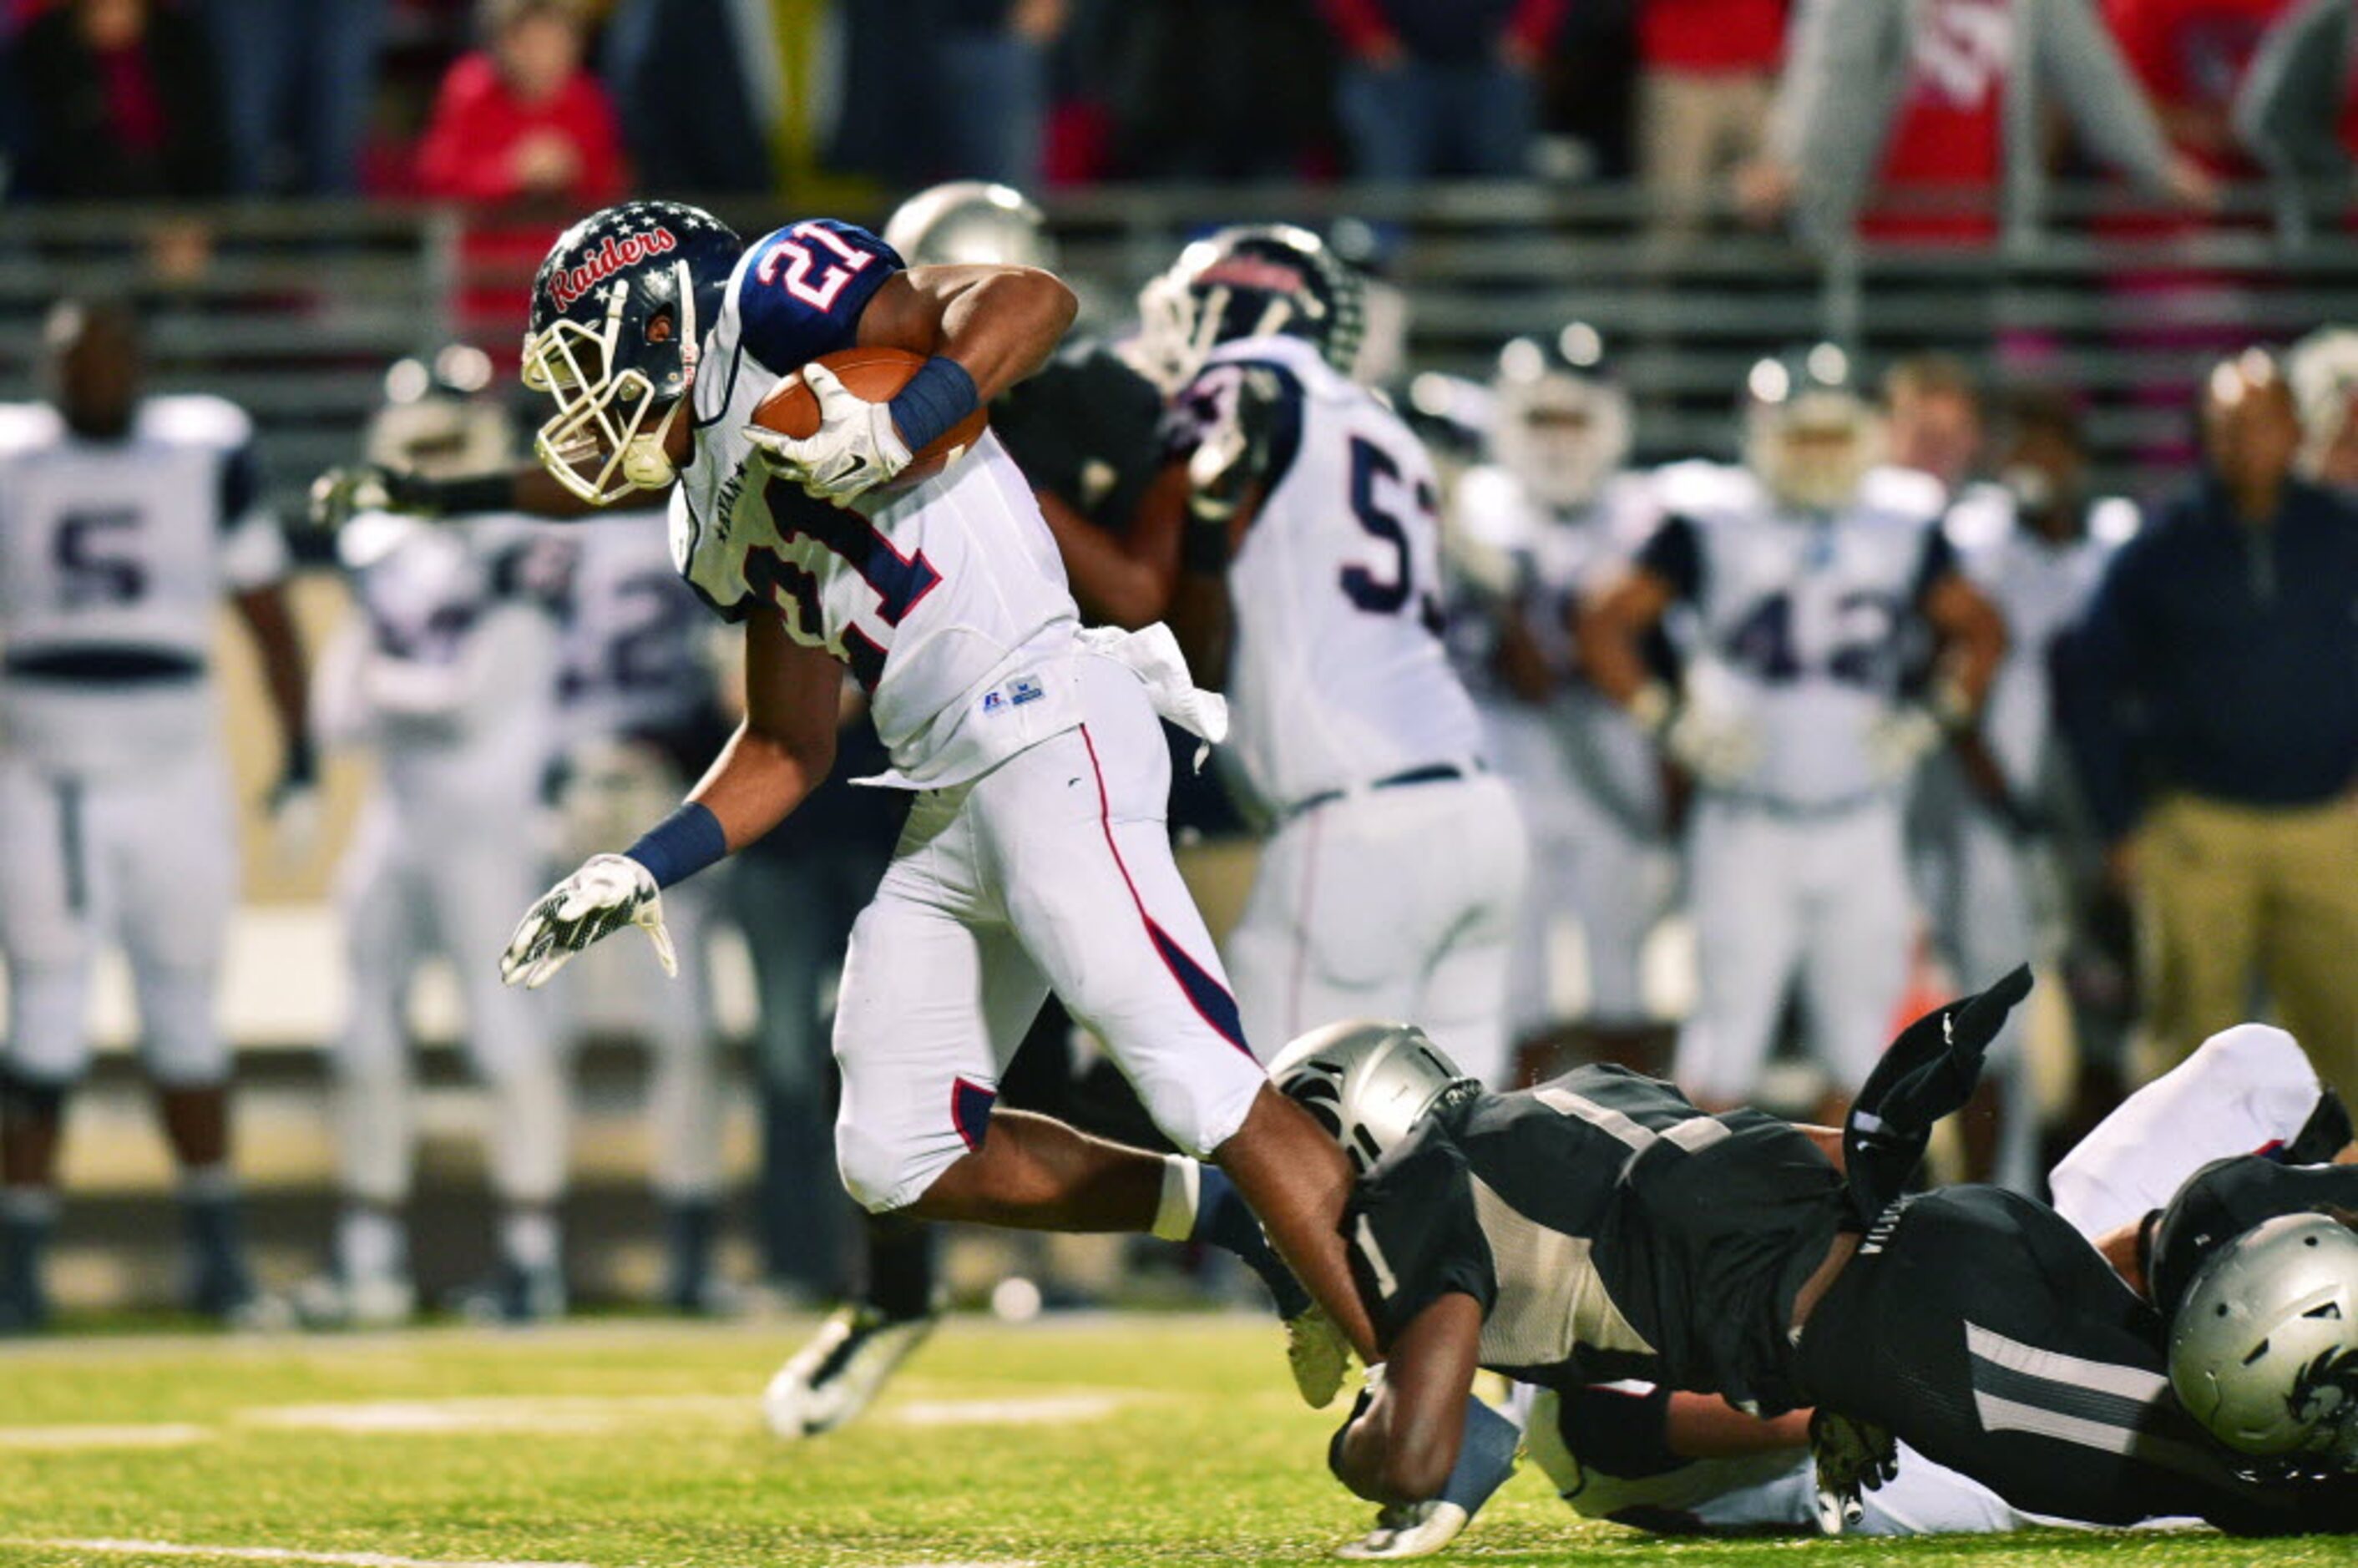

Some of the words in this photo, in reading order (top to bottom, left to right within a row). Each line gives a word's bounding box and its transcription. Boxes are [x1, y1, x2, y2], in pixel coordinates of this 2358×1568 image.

[548, 227, 677, 314] Raiders
[756, 223, 877, 314] 21
[50, 503, 149, 614] 5
[1337, 432, 1448, 638] 5
[1354, 1211, 1399, 1299] 1
